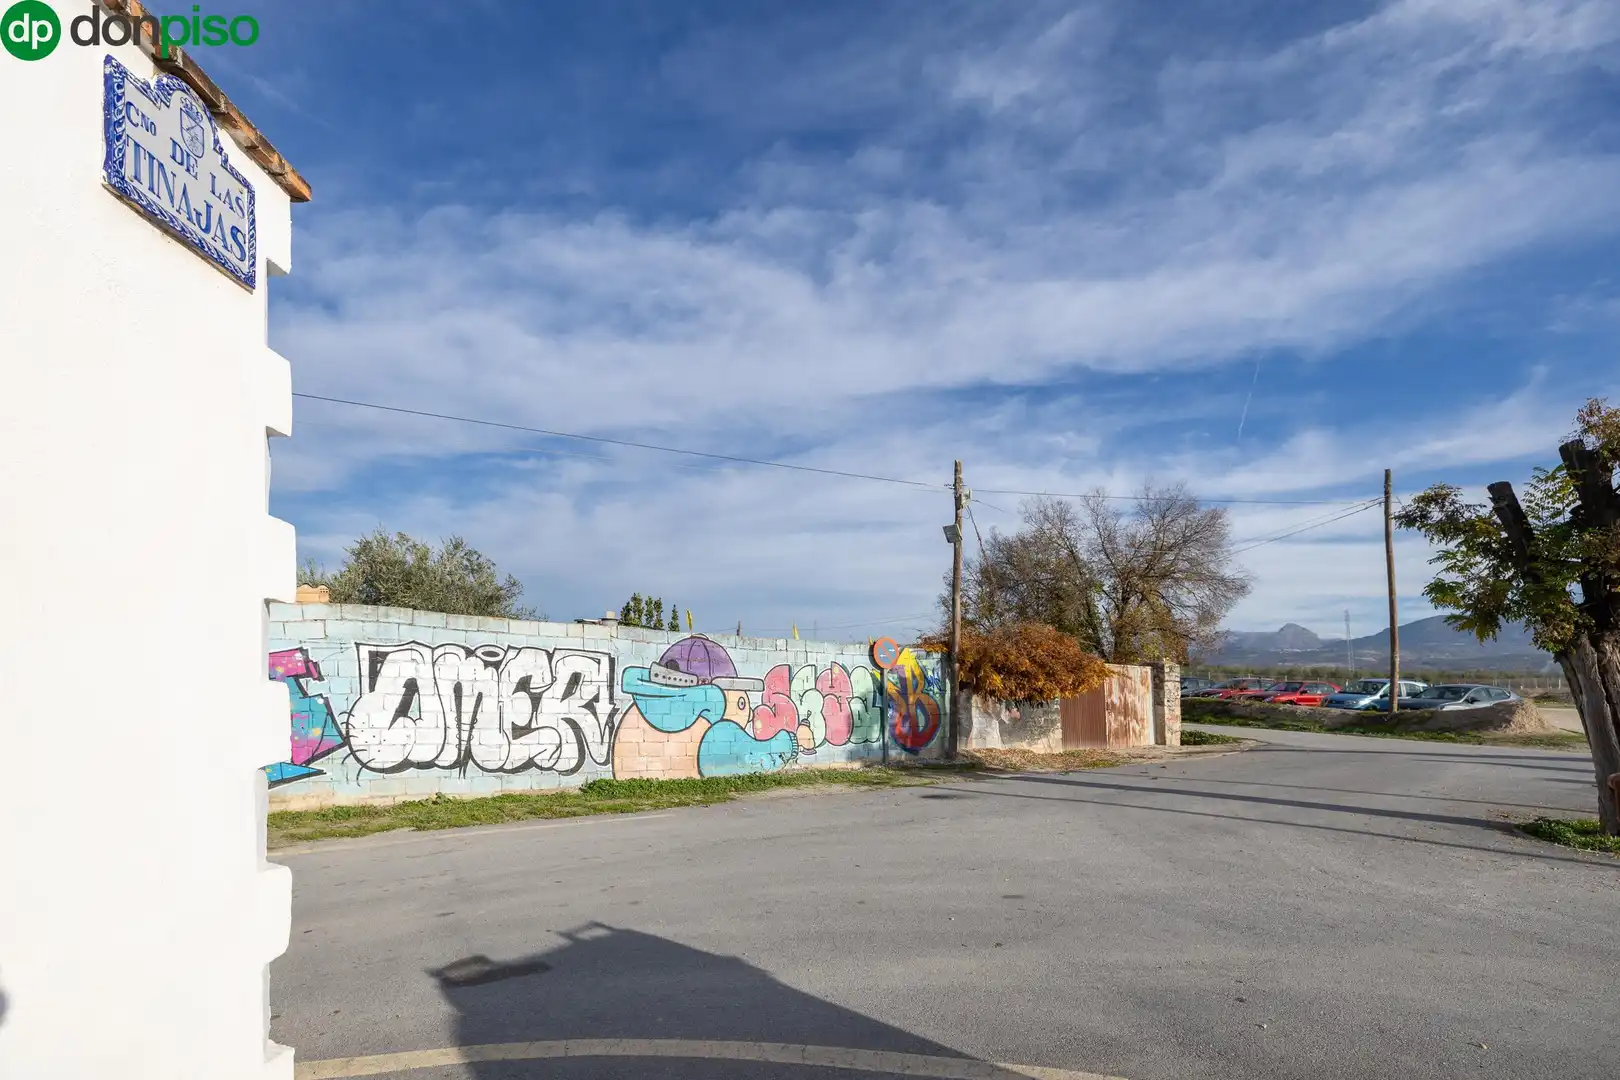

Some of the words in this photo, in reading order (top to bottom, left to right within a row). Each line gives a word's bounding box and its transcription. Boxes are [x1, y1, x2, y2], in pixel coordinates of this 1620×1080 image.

[126, 134, 246, 262] TINAJAS
[170, 137, 198, 180] DE
[210, 172, 245, 219] LAS
